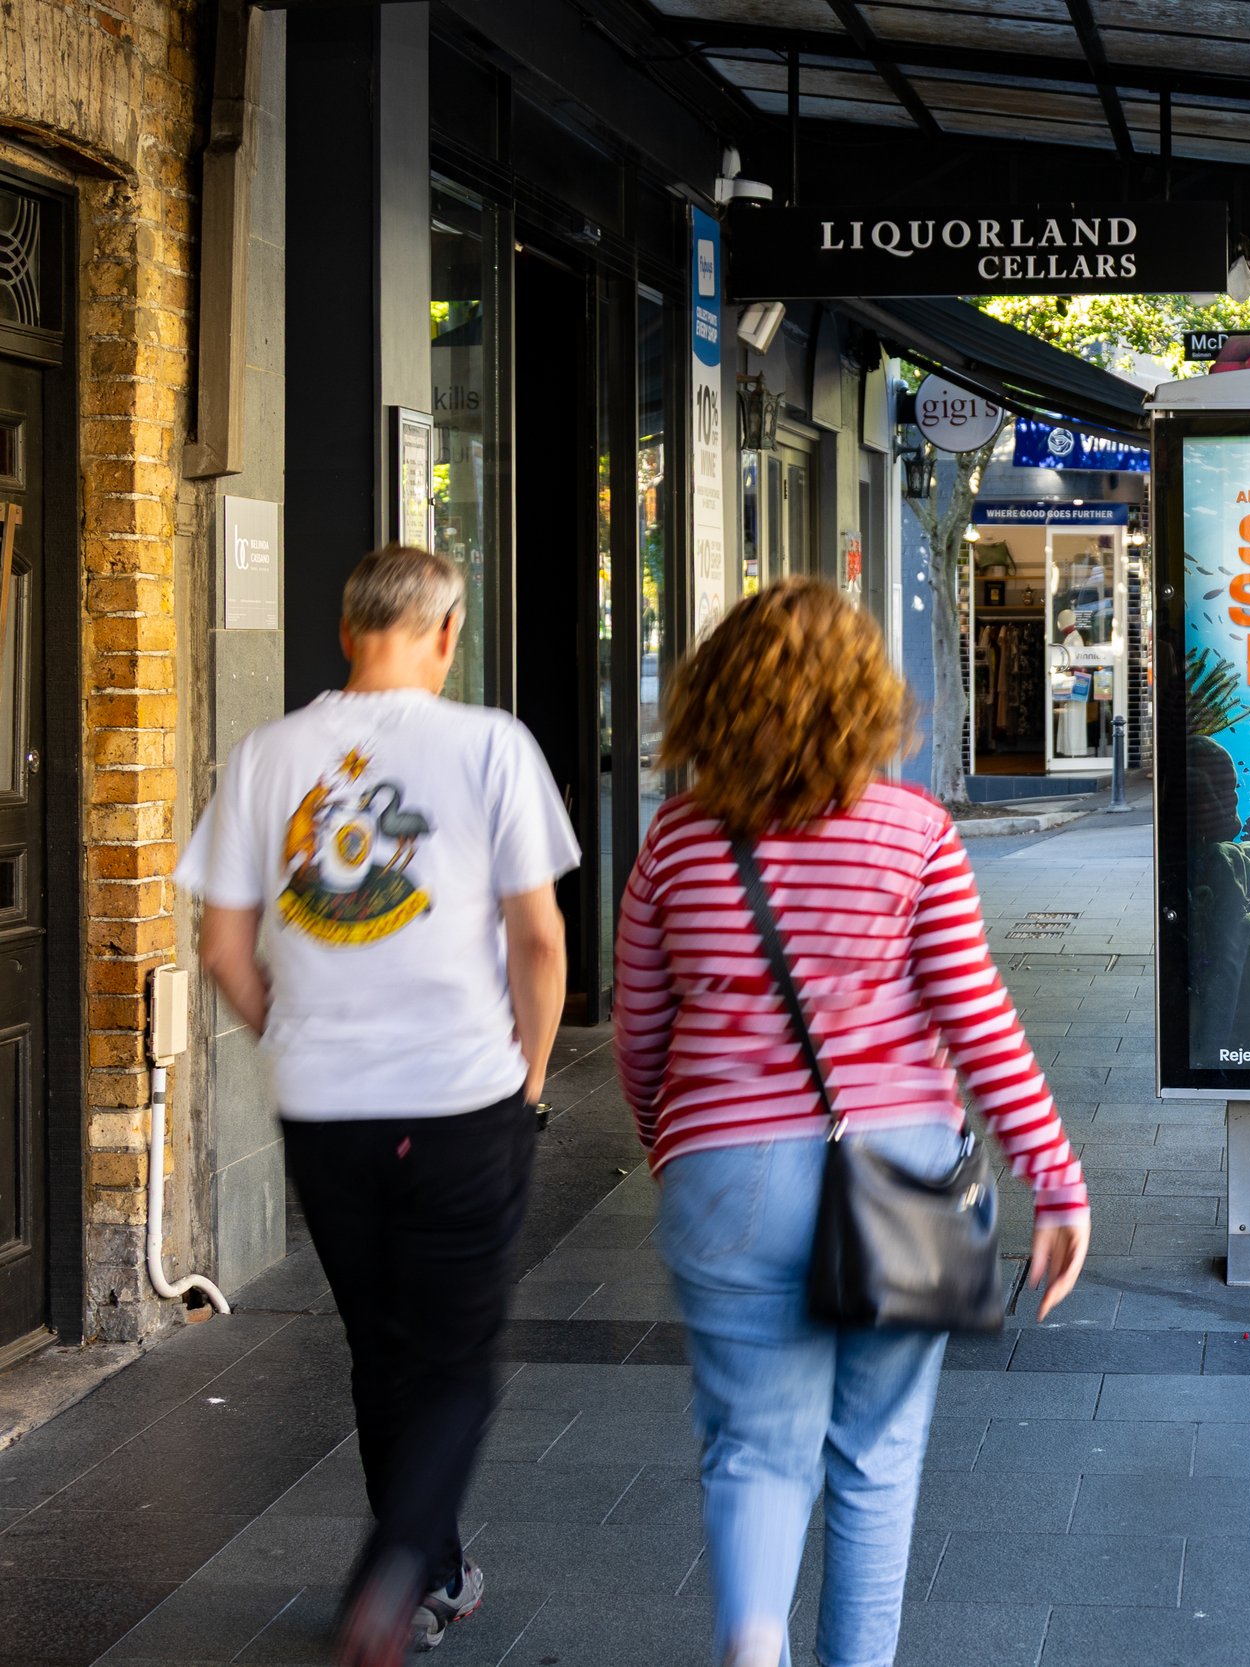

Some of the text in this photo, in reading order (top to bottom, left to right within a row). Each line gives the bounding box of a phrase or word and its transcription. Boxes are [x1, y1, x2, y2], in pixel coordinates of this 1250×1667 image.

[821, 217, 1138, 258] LIQUORLAND
[978, 253, 1137, 279] CELLARS
[921, 389, 999, 427] gigis
[986, 508, 1113, 519] WHERE GOOD GOES FURTHER
